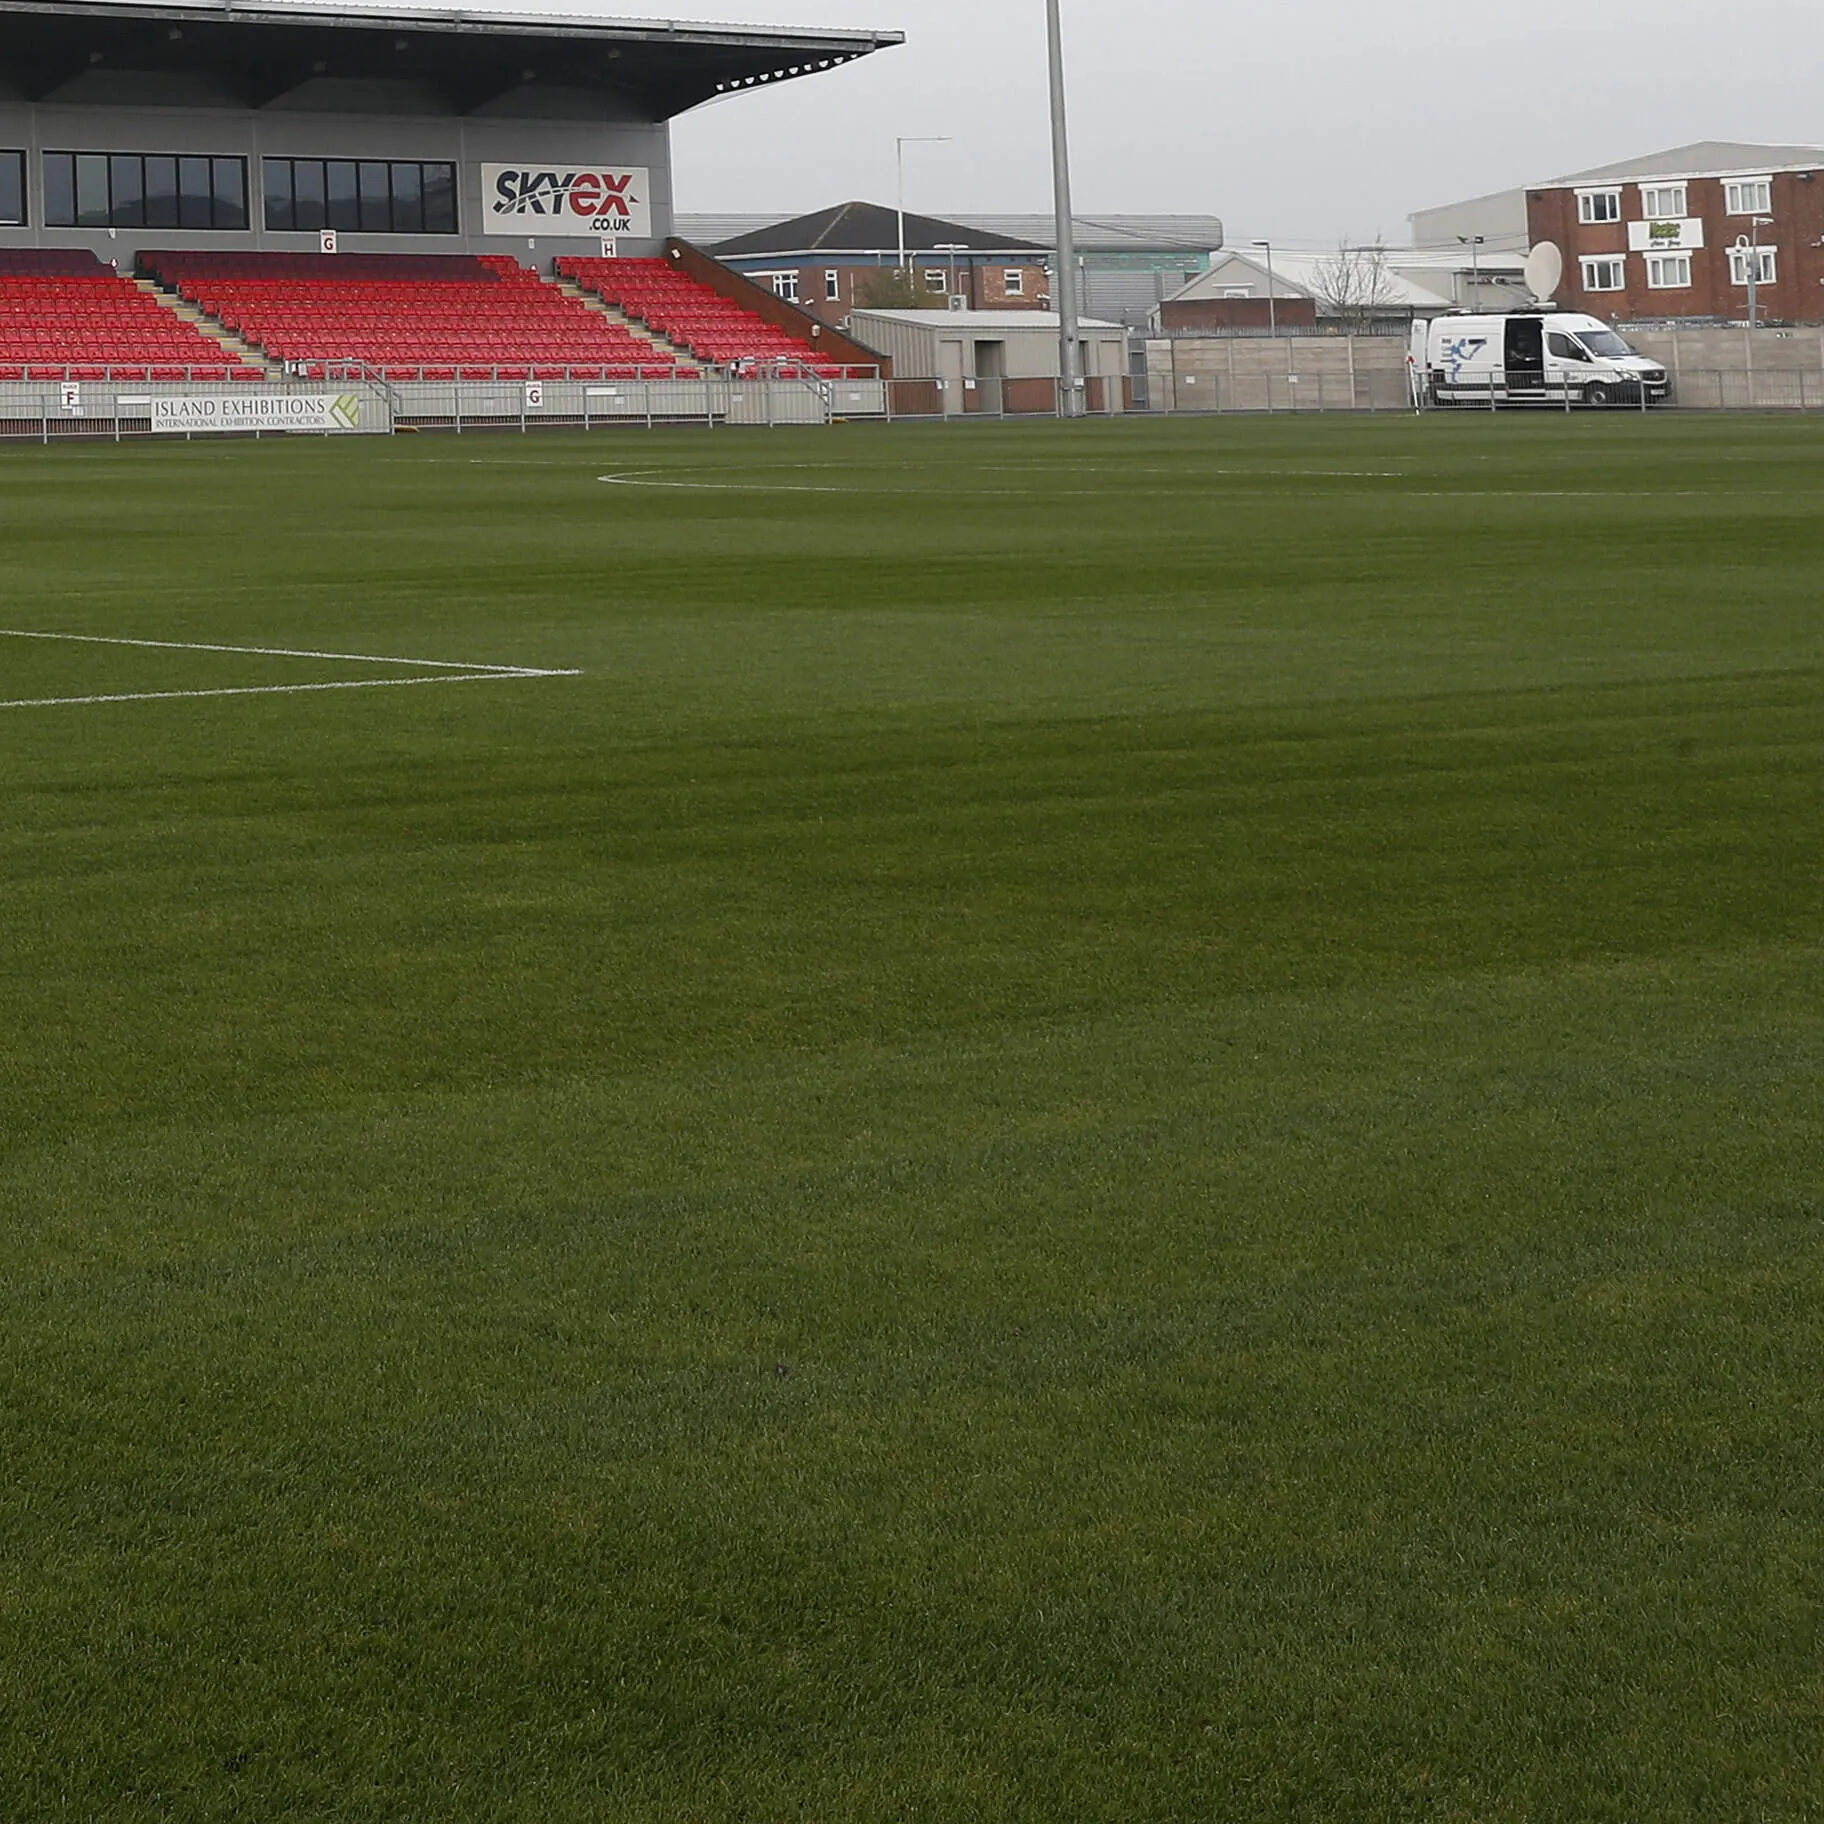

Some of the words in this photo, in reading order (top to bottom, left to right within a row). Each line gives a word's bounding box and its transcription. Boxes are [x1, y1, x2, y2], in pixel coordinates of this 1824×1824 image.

[589, 217, 631, 232] .CO.UK
[323, 237, 334, 250] G
[604, 243, 614, 256] H
[67, 391, 74, 405] F
[529, 389, 540, 404] G
[155, 400, 216, 417] ISLAND
[222, 398, 325, 415] EXHIBITIONS
